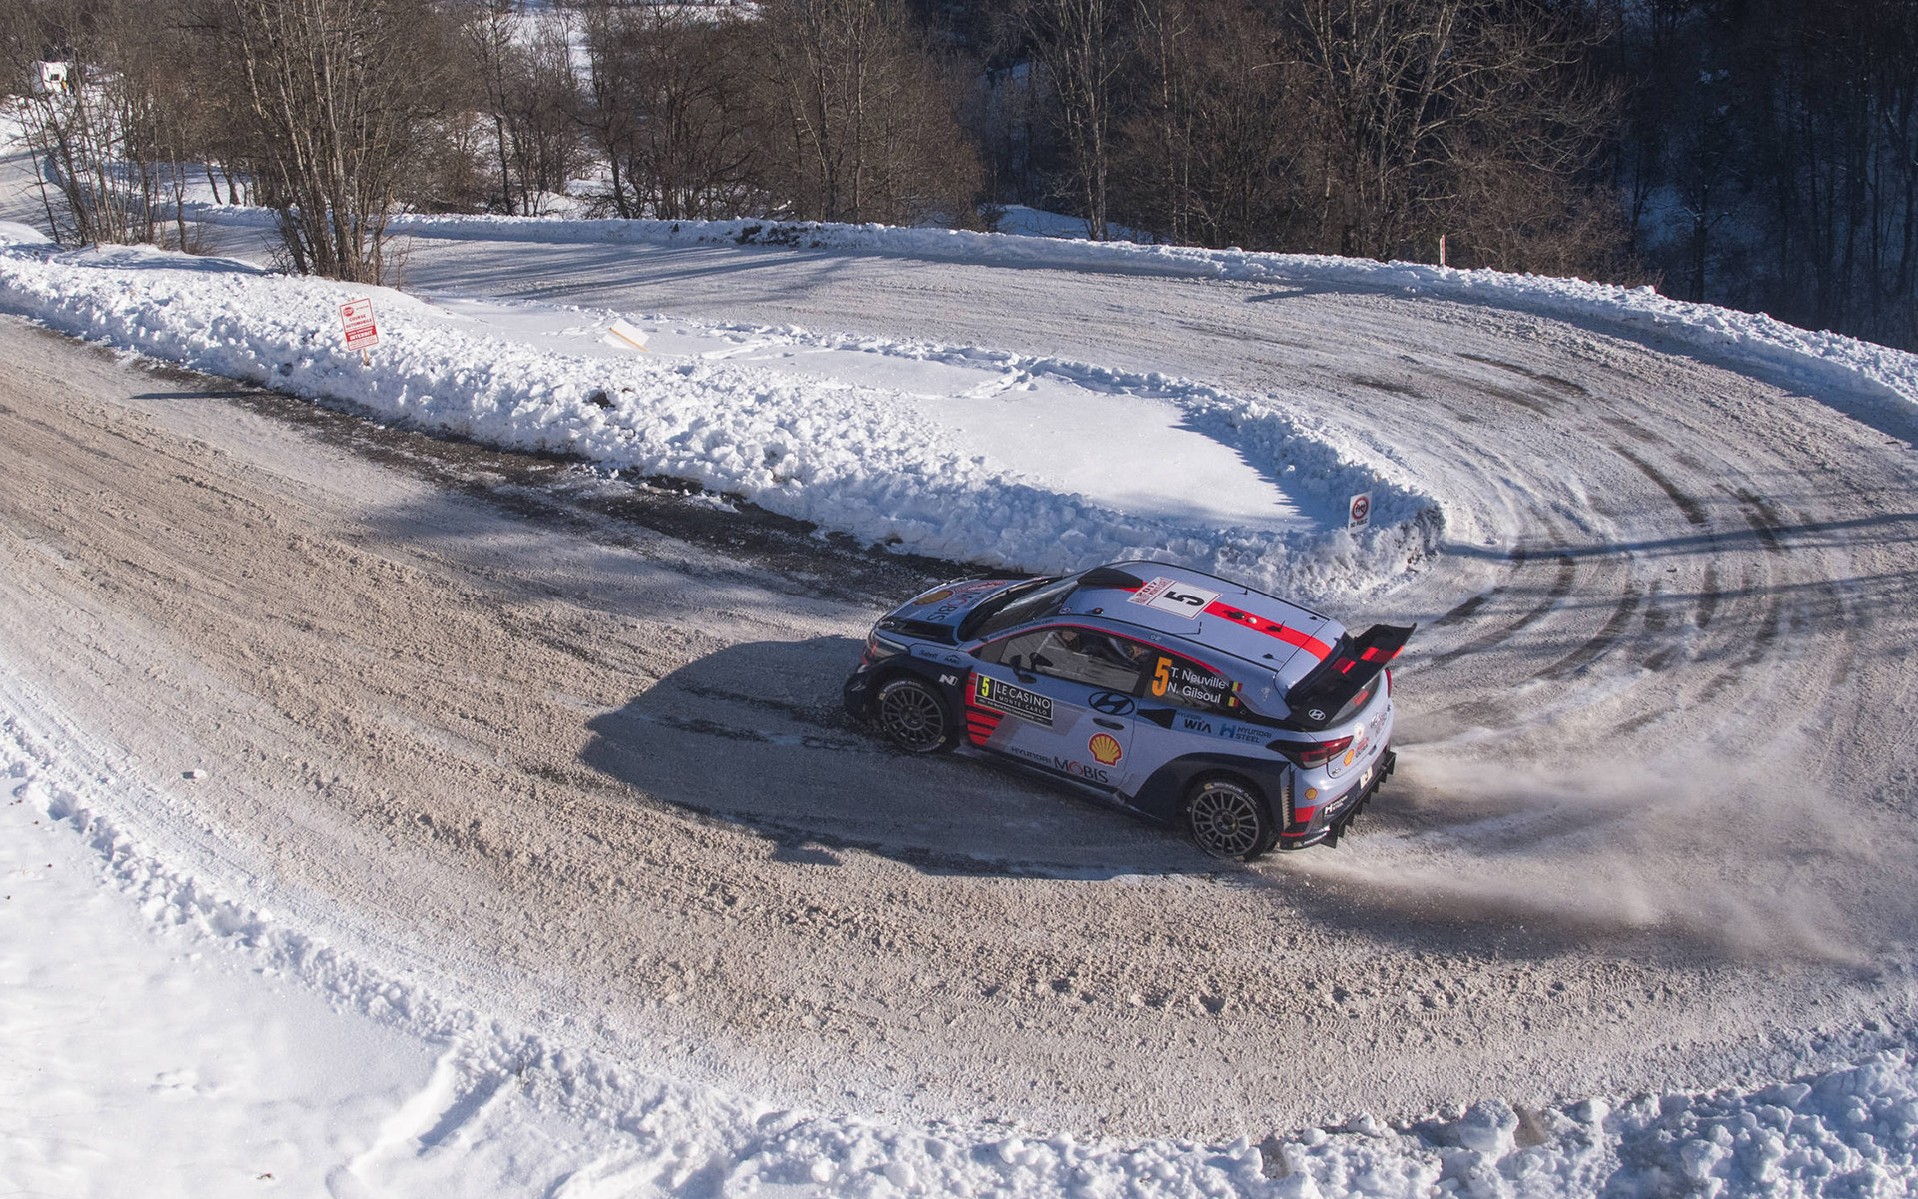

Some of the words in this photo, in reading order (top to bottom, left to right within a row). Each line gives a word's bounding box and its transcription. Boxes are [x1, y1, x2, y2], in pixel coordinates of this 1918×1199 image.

[1163, 590, 1205, 606] 5
[981, 676, 990, 697] 5
[1151, 656, 1173, 697] 5
[1170, 666, 1179, 679] T.
[1181, 670, 1226, 689] Neuville
[996, 683, 1007, 696] LE
[1009, 688, 1051, 709] CASINO
[1167, 681, 1179, 694] N.
[1182, 685, 1222, 704] Gilsoul
[1234, 733, 1261, 744] STEEL
[1237, 726, 1272, 739] HYUNDAI
[1054, 756, 1109, 784] MOBIS
